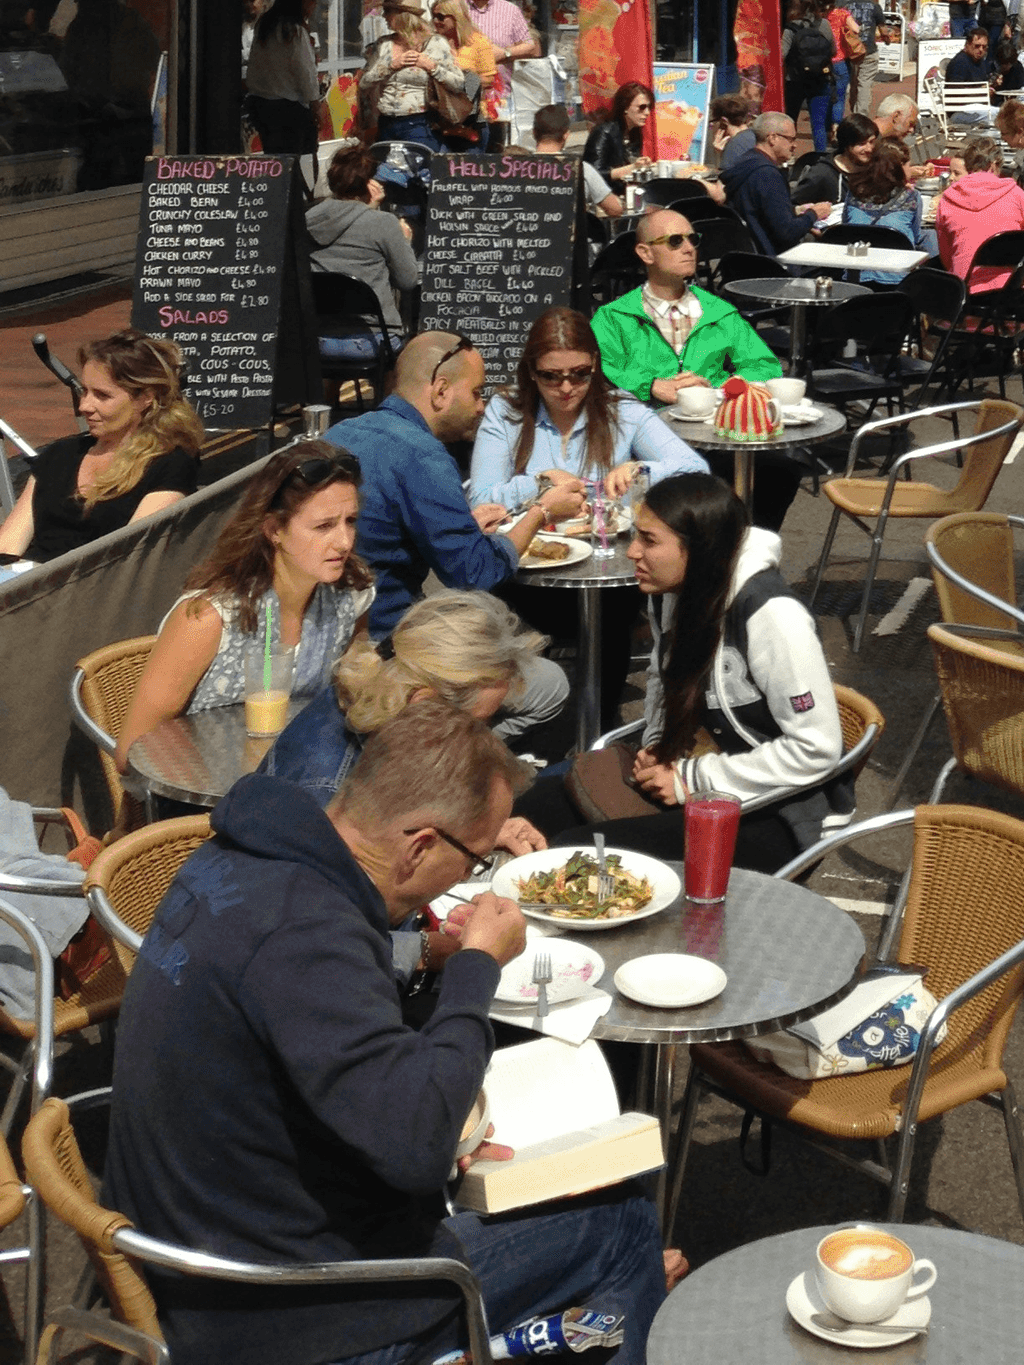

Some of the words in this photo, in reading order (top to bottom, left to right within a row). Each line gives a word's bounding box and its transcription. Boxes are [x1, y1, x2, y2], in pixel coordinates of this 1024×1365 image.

[157, 158, 216, 179] BAKED
[225, 159, 283, 178] POTATO
[449, 158, 496, 177] HELLS
[148, 182, 194, 195] CHEDDAR
[197, 182, 231, 194] CHEESE
[148, 196, 181, 207] BAKED
[190, 196, 219, 207] BEAN
[448, 195, 474, 206] WRAP
[149, 210, 192, 222] CRUNCHY
[194, 210, 239, 221] COLESLAW
[455, 211, 475, 220] WITH
[482, 211, 508, 221] GREEN
[513, 211, 539, 222] SALAD
[543, 212, 562, 222] AND
[149, 222, 173, 234] TUNA
[177, 223, 203, 234] MAYO
[146, 237, 181, 248] CHEESE
[184, 238, 198, 247] AND
[199, 237, 225, 248] BEANS
[427, 235, 449, 247] HOT
[450, 238, 491, 248] CHORIZO
[492, 238, 514, 248] WITH
[516, 238, 551, 248] MELTED
[144, 251, 179, 262] CHICKEN
[182, 250, 213, 260] CURRY
[427, 250, 458, 260] CHEESE
[143, 265, 163, 276] HOT
[167, 265, 205, 275] CHORIZO
[219, 265, 251, 275] CHEESE
[426, 263, 448, 275] HOT
[448, 264, 473, 275] SALT
[475, 264, 500, 275] BEEF
[502, 265, 521, 275] WITH
[527, 265, 564, 277] PICKLED
[139, 277, 173, 288] PRAWN
[177, 277, 201, 288] MAYO
[433, 277, 456, 289] DILL
[464, 278, 496, 290] BAGEL
[144, 291, 161, 303] ADD
[163, 292, 170, 302] A
[175, 292, 193, 302] SIDE
[195, 293, 217, 303] SALAD
[220, 292, 236, 302] FOR
[524, 293, 538, 304] ON
[543, 293, 553, 304] A
[159, 305, 229, 328] SALADS
[423, 317, 452, 330] SPICY
[456, 319, 506, 330] MEATBALLS
[509, 321, 519, 330] IN
[173, 332, 198, 342] FROM
[200, 332, 207, 341] A
[210, 332, 257, 342] SELECTION
[262, 332, 276, 342] OF
[207, 374, 227, 384] WITH
[252, 372, 273, 383] PASTA
